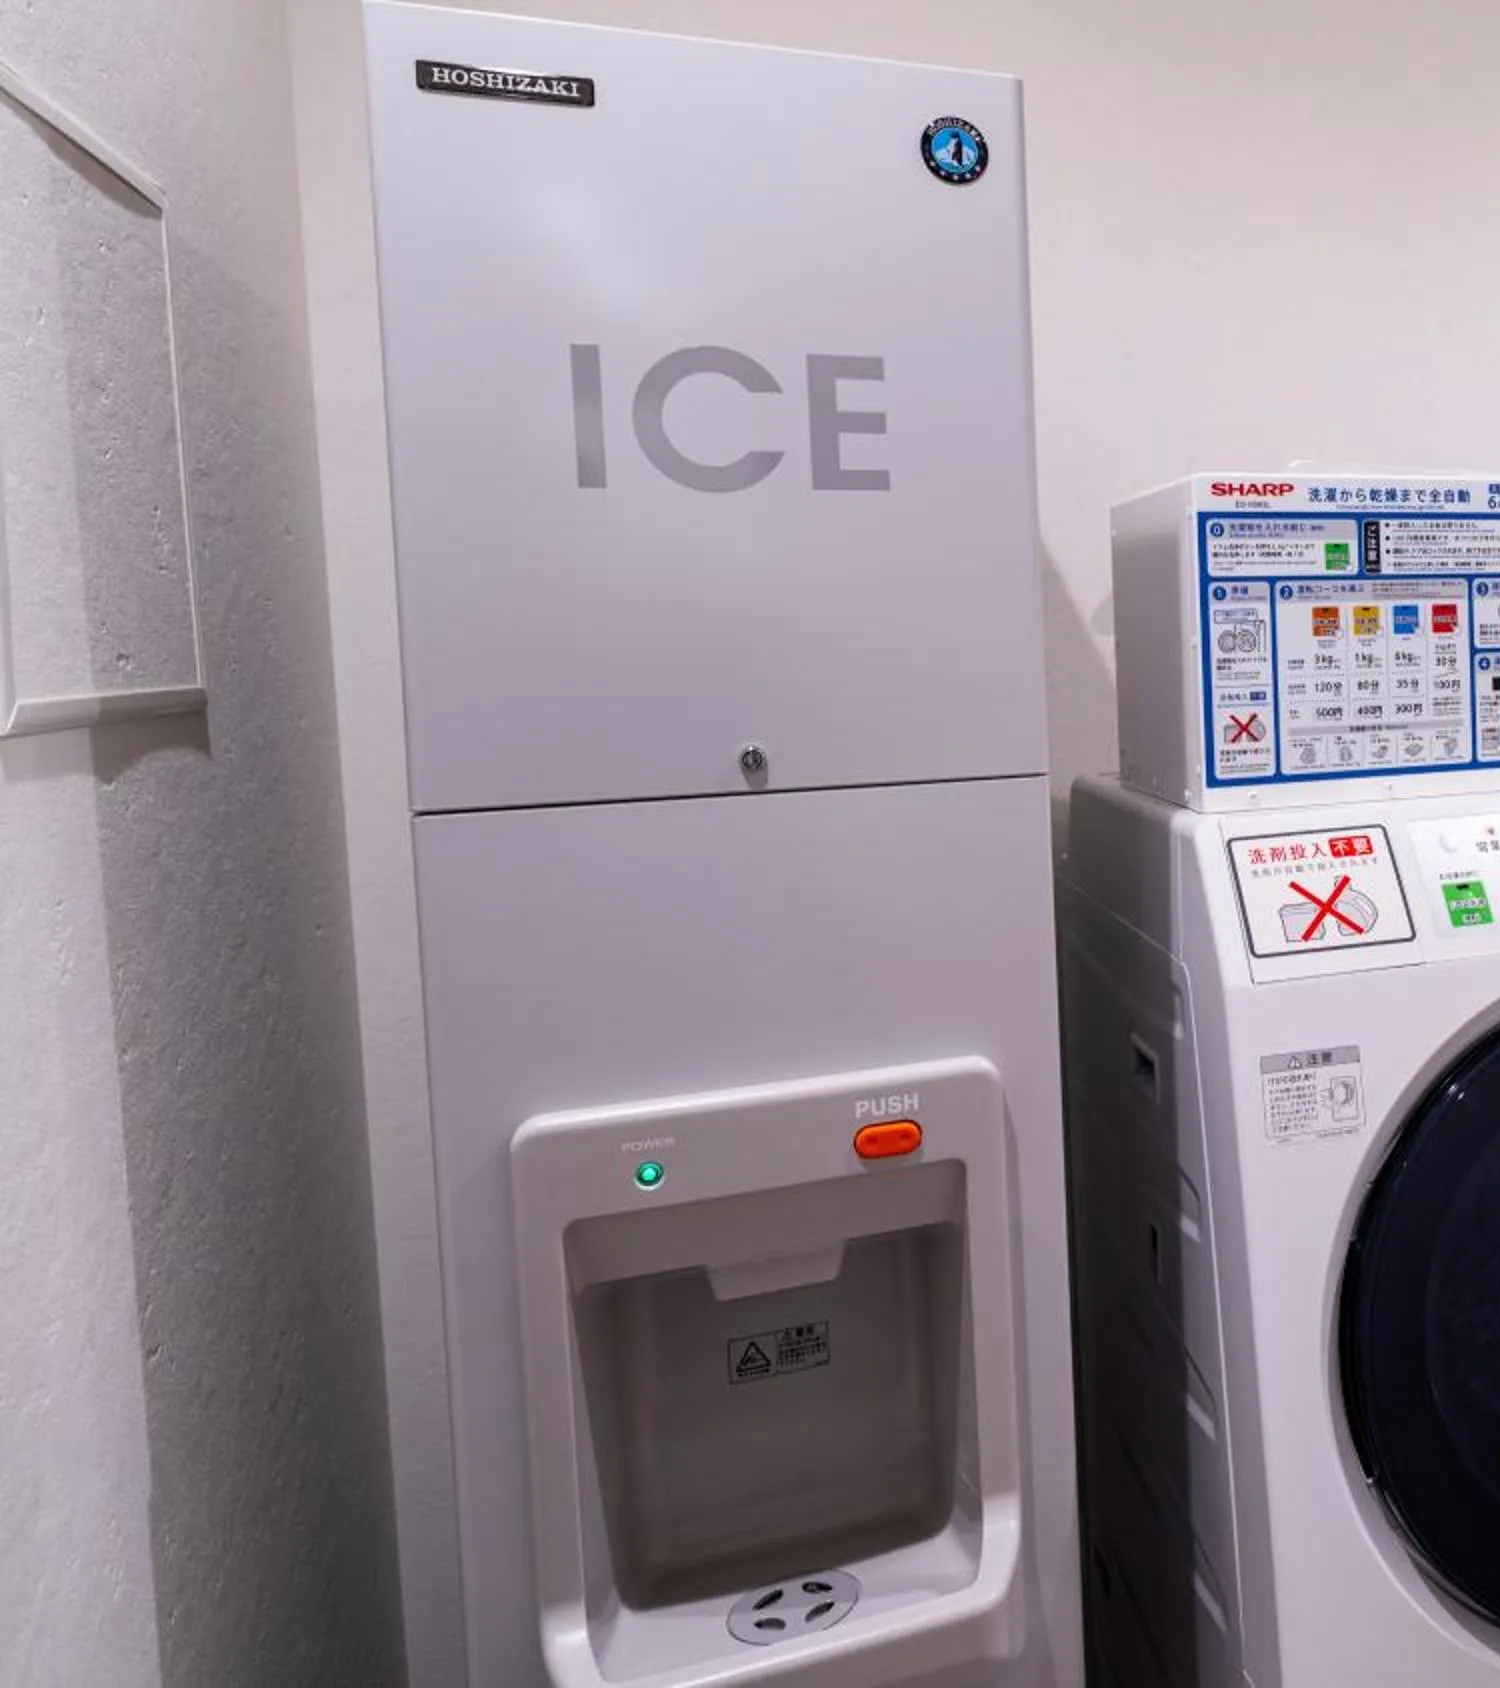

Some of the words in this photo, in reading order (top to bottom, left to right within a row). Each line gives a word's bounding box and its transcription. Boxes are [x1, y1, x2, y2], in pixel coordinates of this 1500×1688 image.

[431, 66, 580, 98] HOSHIZAKI
[570, 343, 891, 494] ICE
[1210, 482, 1295, 497] SHARP
[1308, 486, 1472, 504] 洗濯から乾燥まで全自動
[1249, 843, 1328, 865] 洗剤投入
[1329, 836, 1373, 858] 不要
[854, 1093, 920, 1119] PUSH
[621, 1136, 676, 1152] POWER
